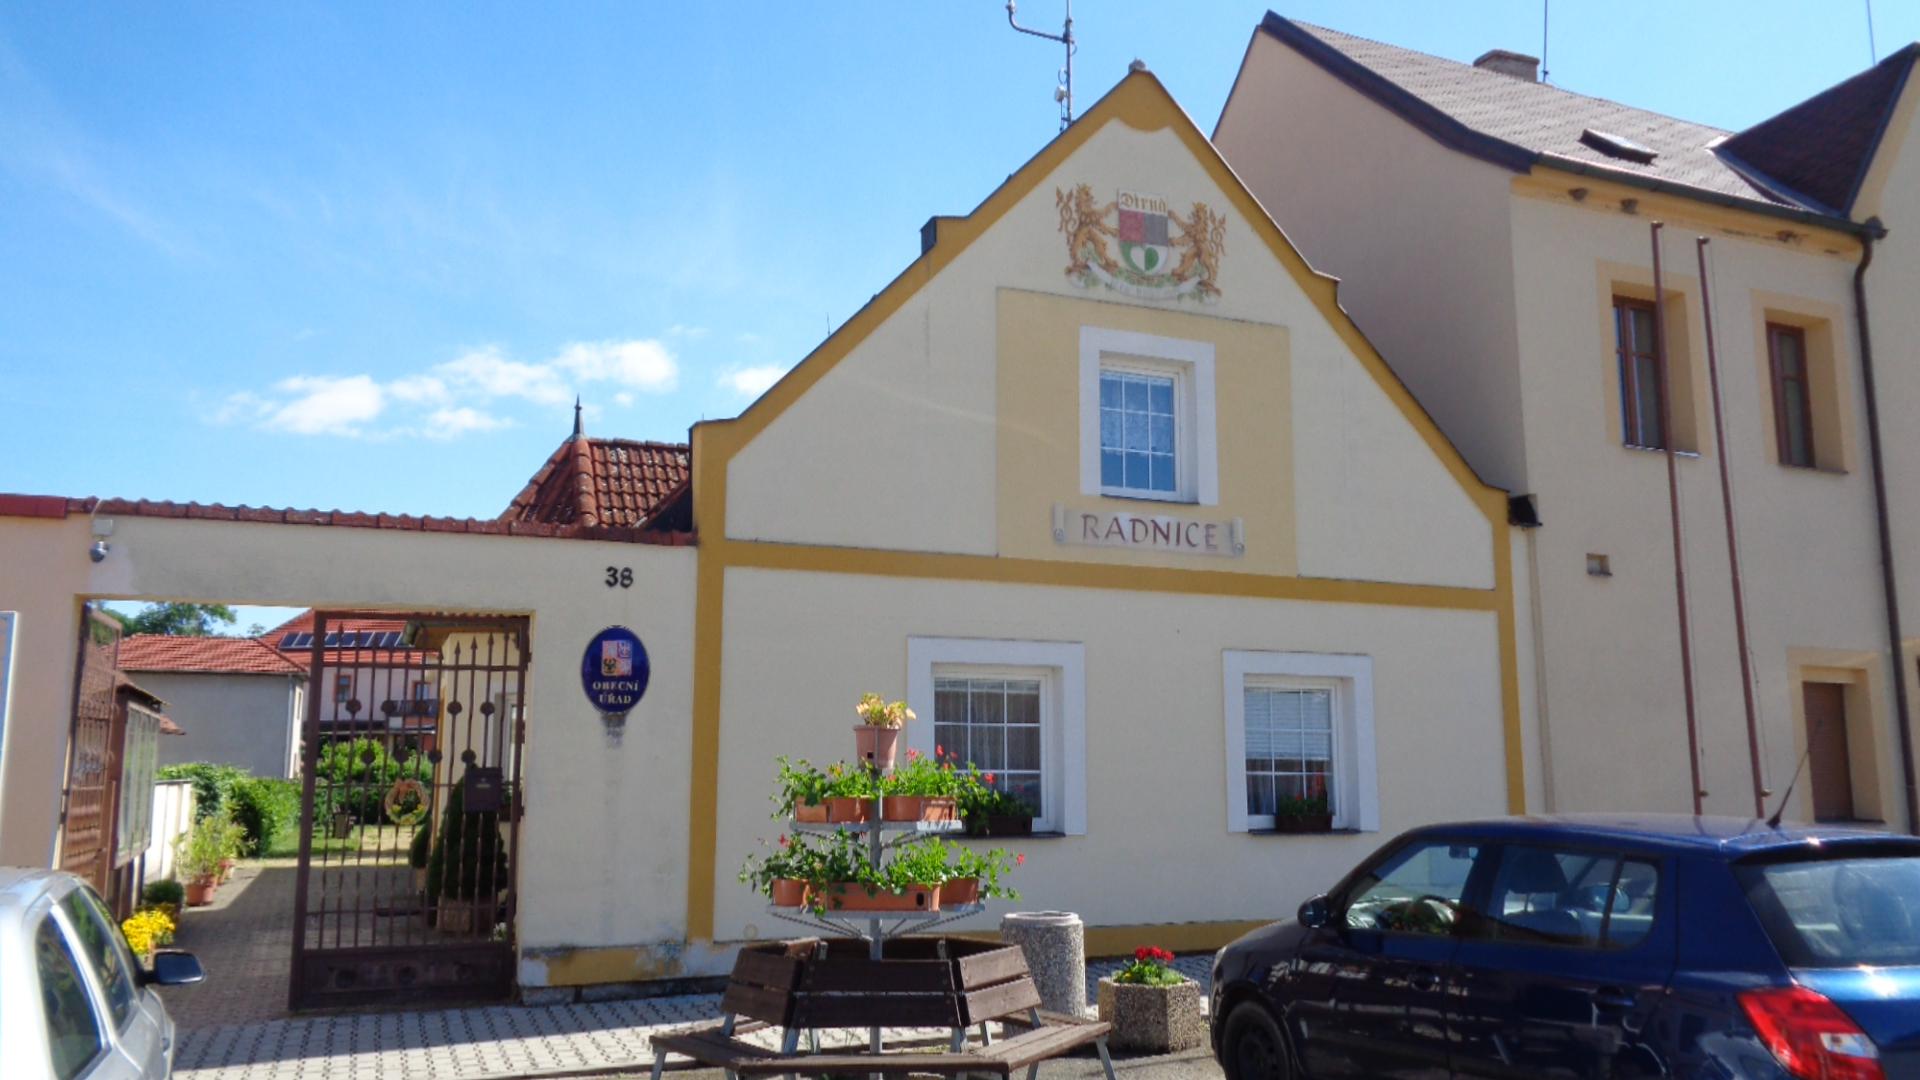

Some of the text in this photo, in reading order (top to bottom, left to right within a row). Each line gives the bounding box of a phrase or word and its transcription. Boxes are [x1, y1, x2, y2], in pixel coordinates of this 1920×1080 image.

[1081, 514, 1218, 550] RADNICE
[605, 566, 634, 589] 38
[592, 680, 640, 692] OBECNÍ
